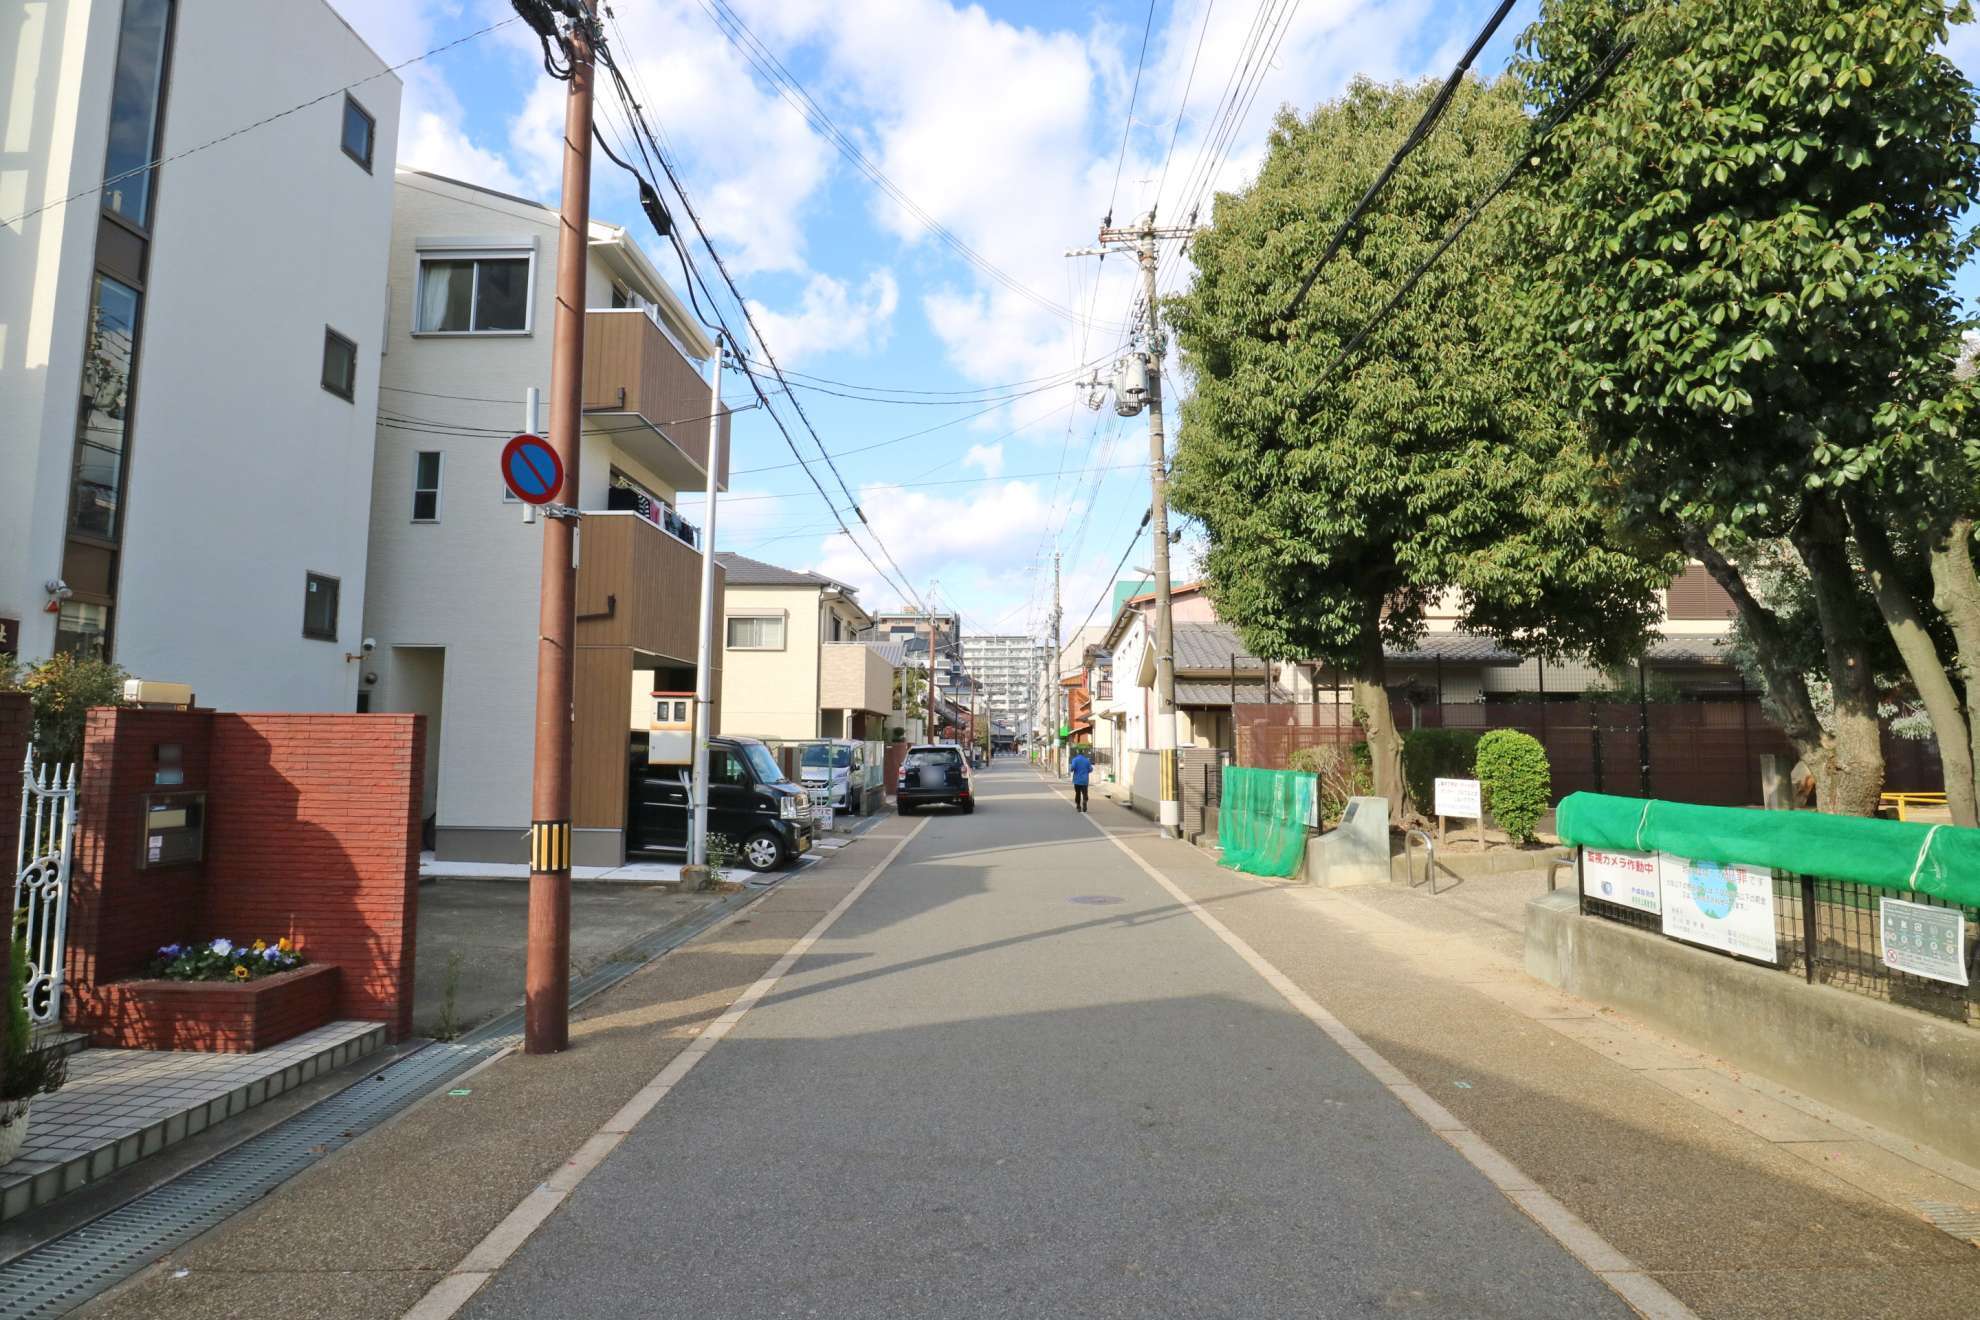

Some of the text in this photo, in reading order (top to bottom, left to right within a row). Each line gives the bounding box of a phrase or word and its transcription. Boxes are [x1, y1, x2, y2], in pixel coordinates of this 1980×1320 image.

[1587, 850, 1654, 874] 監視カメラ作動中
